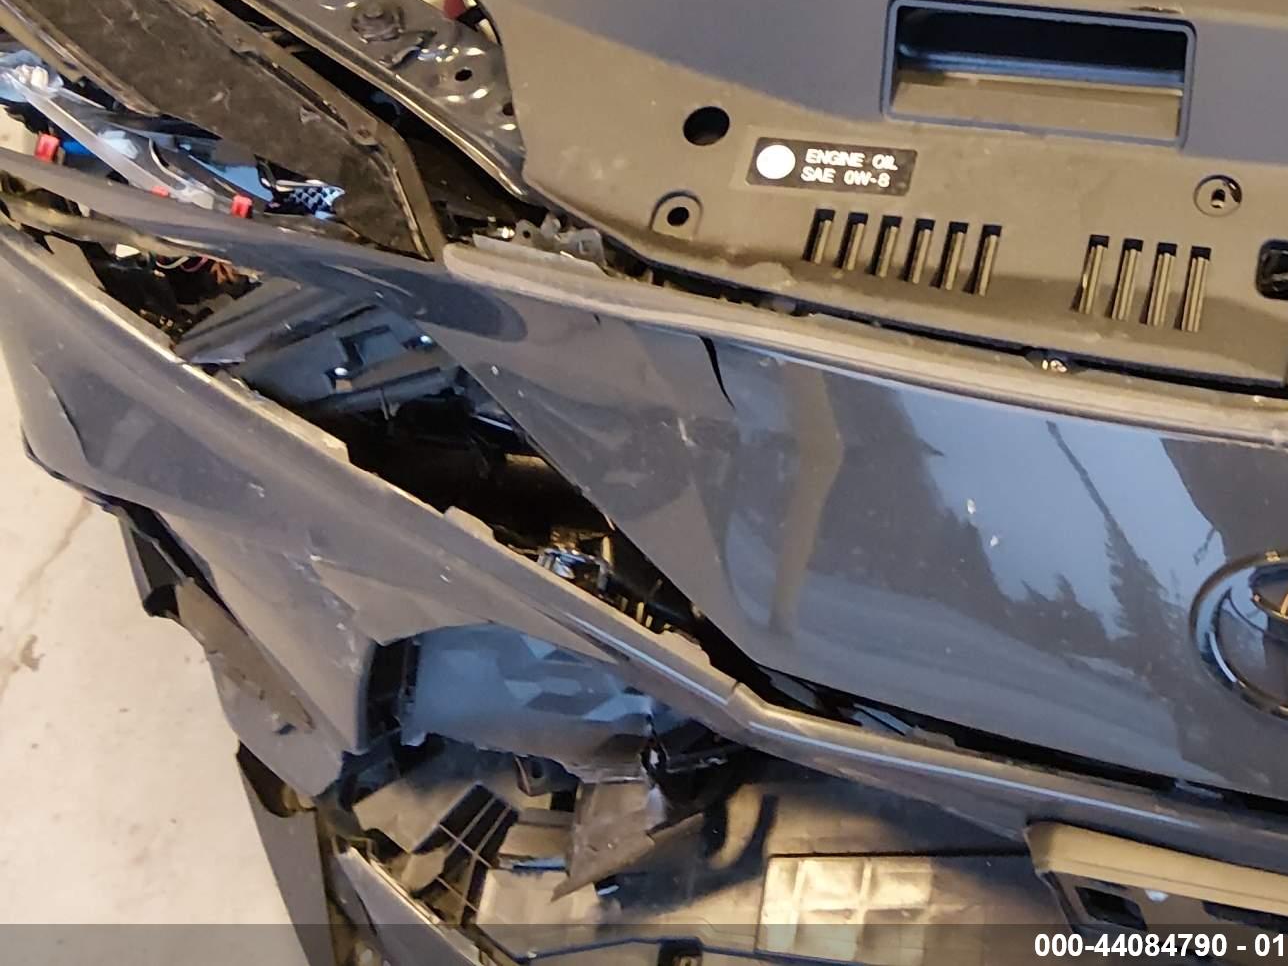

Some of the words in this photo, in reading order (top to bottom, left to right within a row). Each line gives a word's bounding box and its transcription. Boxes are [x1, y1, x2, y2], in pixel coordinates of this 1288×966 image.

[805, 148, 865, 168] ENGINE
[871, 153, 898, 171] OIL
[801, 166, 836, 184] SAE
[843, 169, 891, 188] 0W-8
